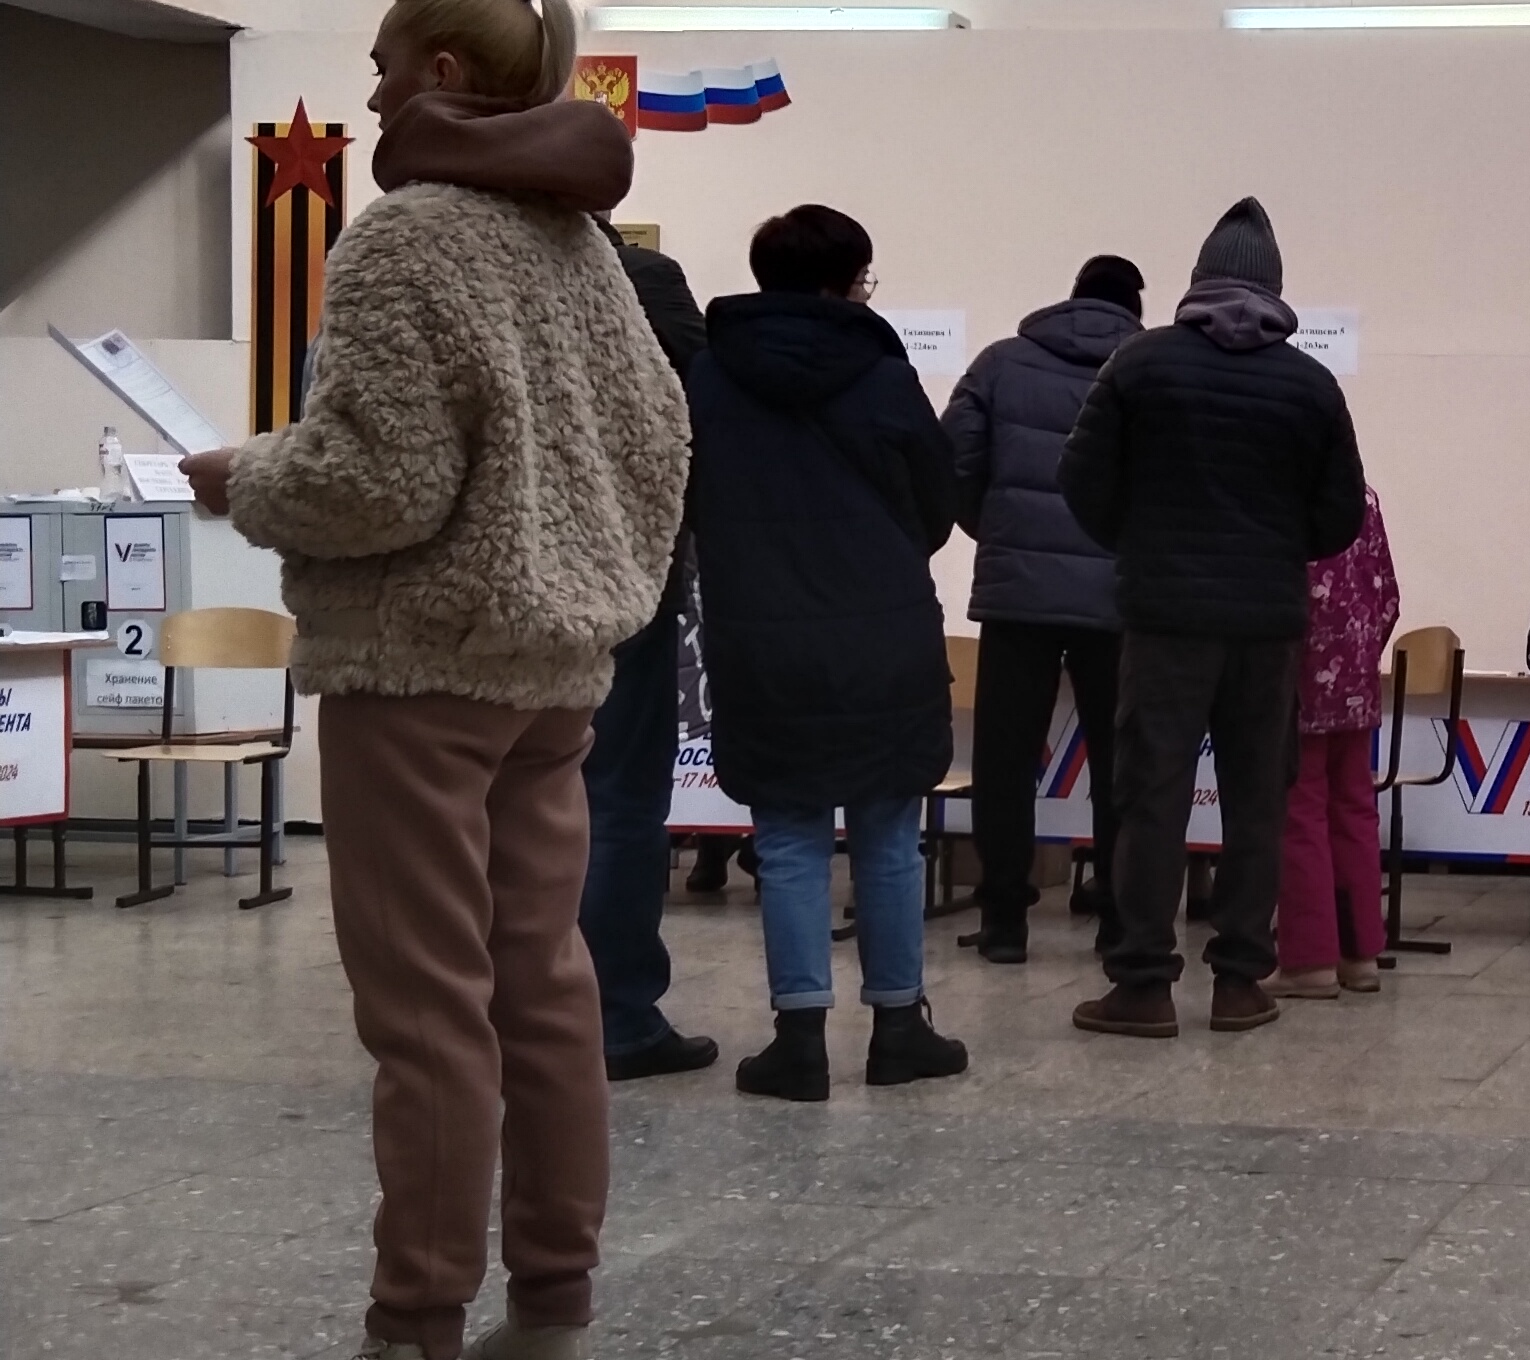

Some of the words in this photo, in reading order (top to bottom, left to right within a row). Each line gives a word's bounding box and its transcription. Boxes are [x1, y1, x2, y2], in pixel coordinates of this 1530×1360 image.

[1296, 327, 1338, 335] атищева
[124, 624, 143, 655] 2
[105, 673, 158, 687] Хранение
[97, 692, 123, 707] сейф
[125, 695, 163, 706] пакето
[1193, 788, 1218, 807] 024
